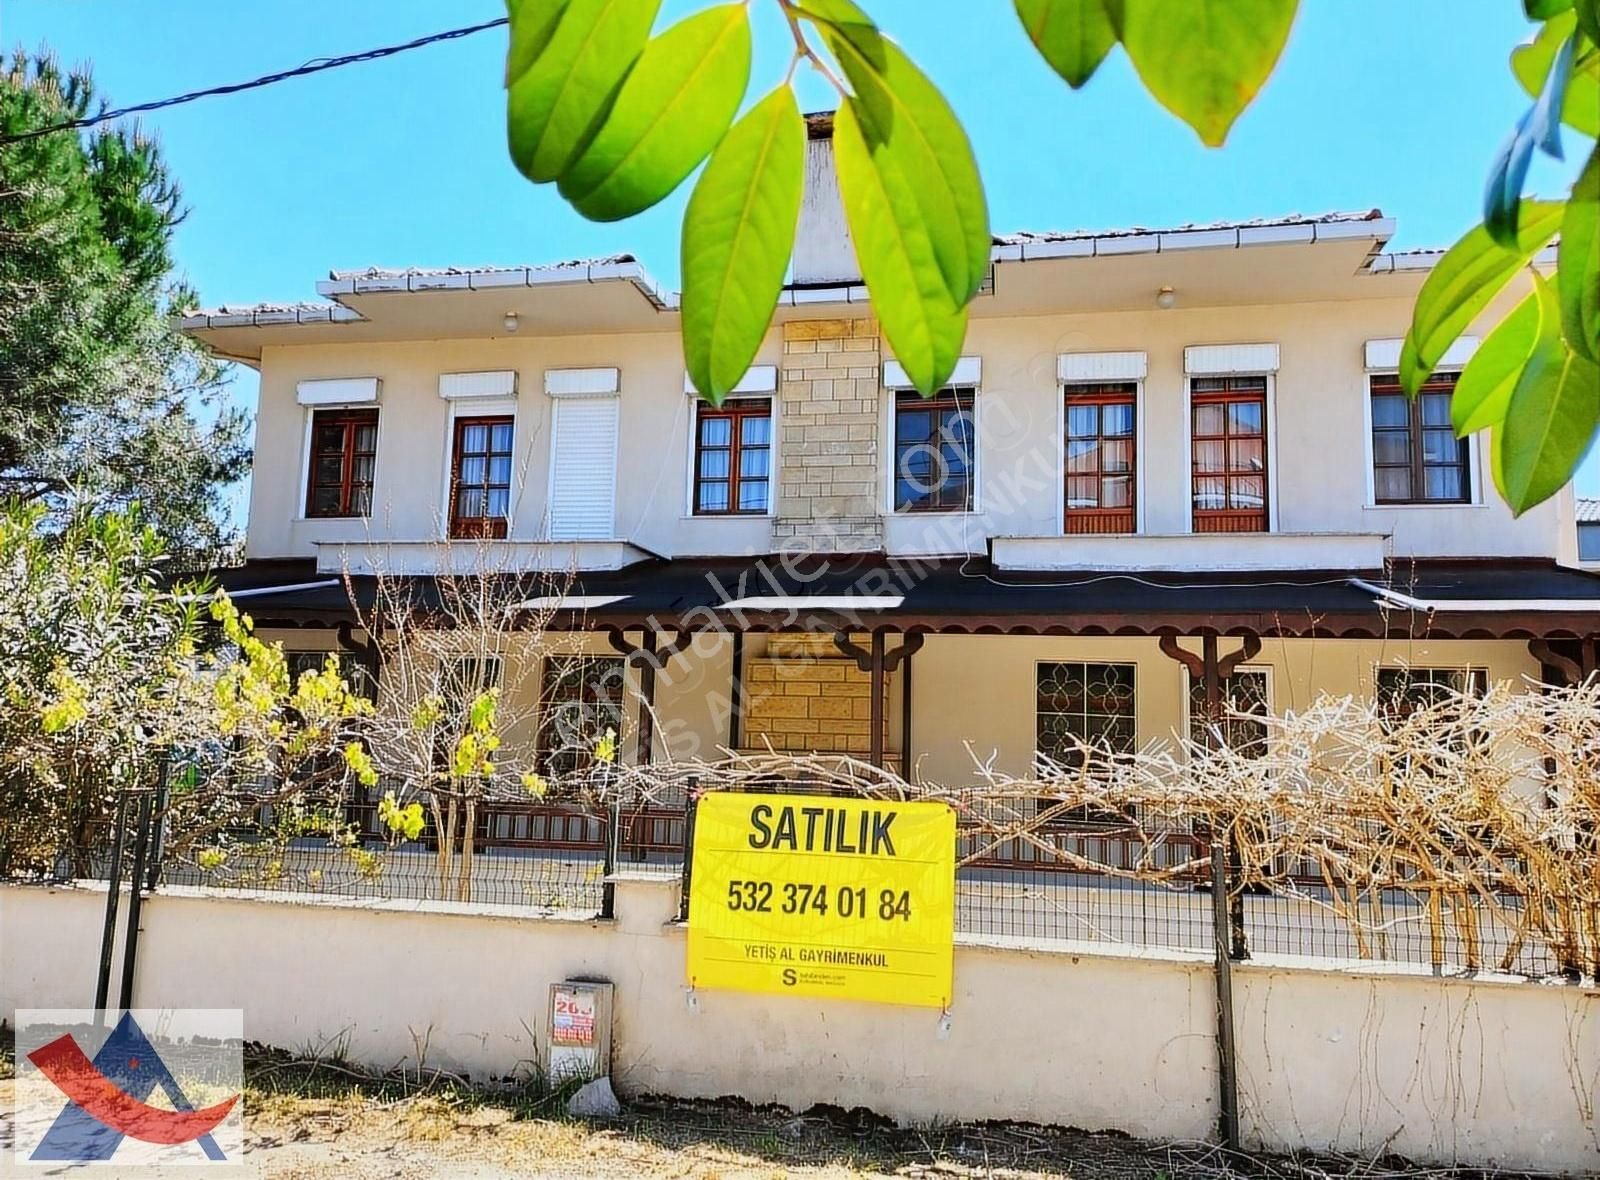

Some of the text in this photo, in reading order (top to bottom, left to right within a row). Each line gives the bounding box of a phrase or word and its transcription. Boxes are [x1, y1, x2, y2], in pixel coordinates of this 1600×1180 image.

[748, 804, 897, 856] SATILIK
[727, 880, 911, 922] 532 374 01 84
[744, 944, 889, 967] YETİŞ AL GAYRİMENKUL
